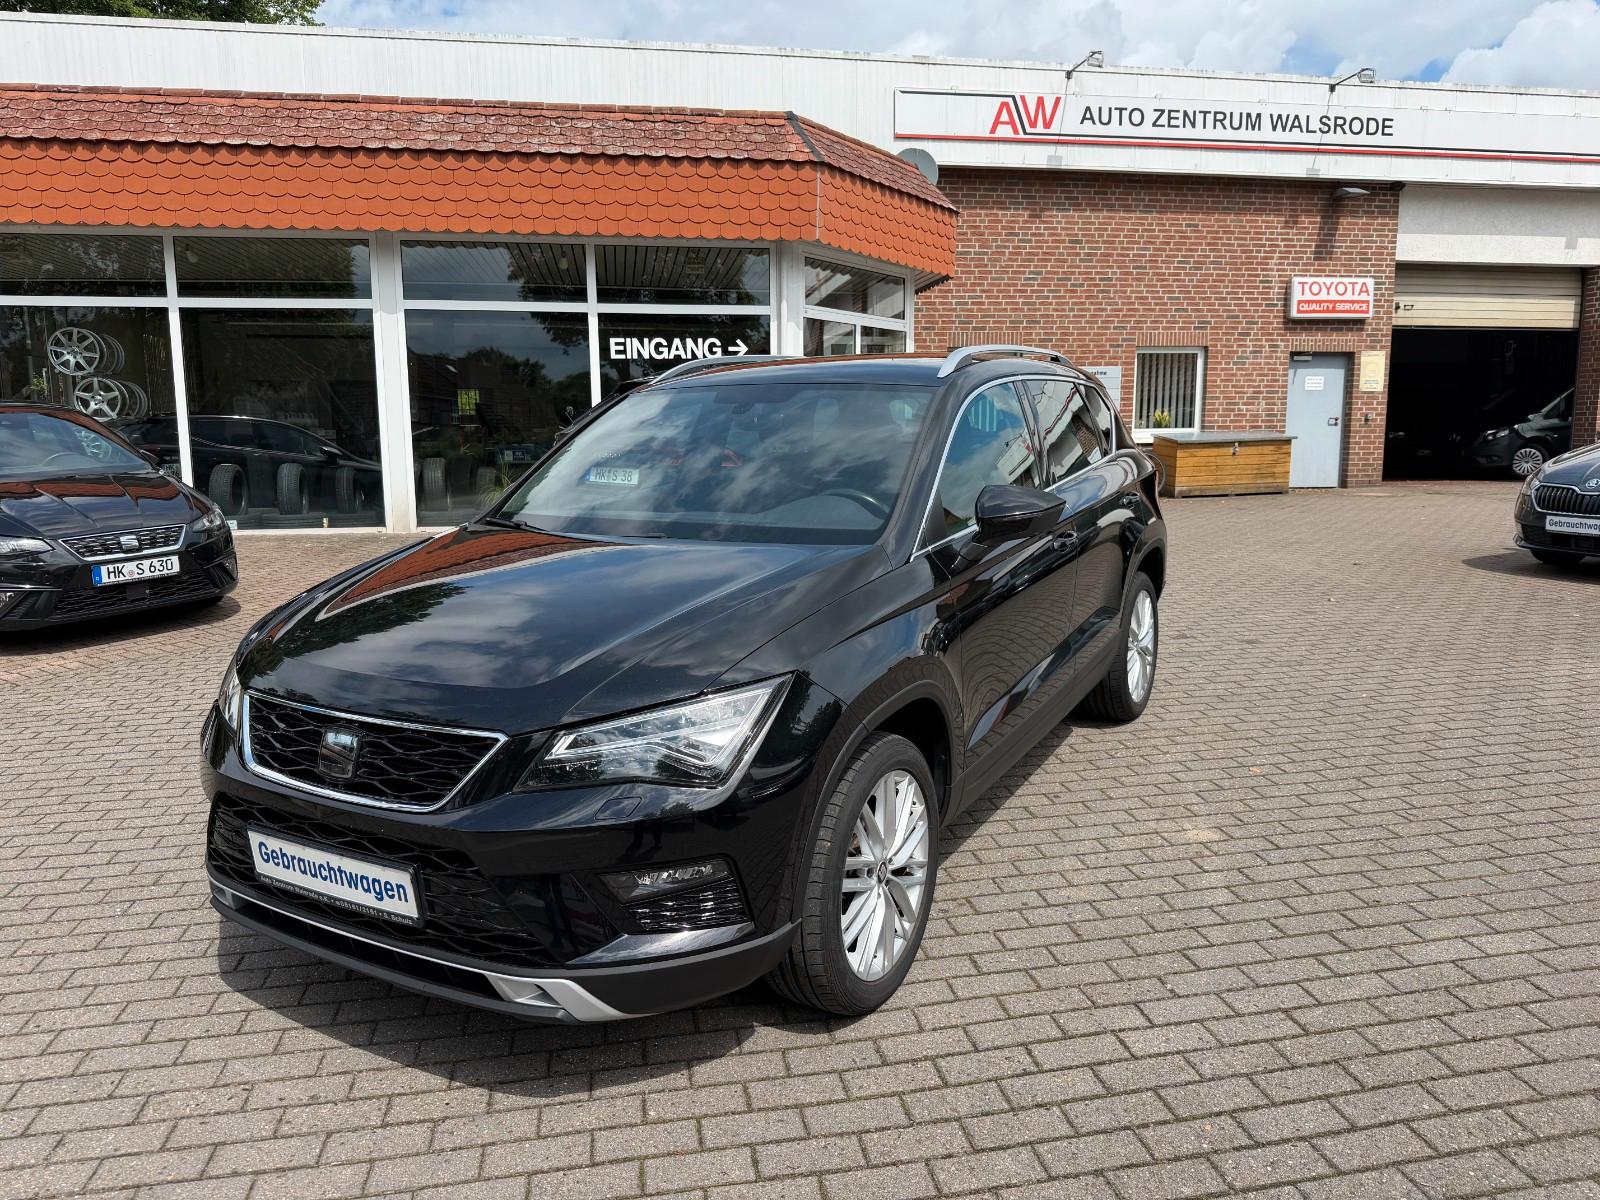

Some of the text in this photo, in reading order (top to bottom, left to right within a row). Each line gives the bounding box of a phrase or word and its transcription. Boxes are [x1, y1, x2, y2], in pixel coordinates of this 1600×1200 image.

[989, 95, 1394, 136] AW AUTO ZENTRUM WALSRODE
[1297, 281, 1370, 296] TOYOTA
[1299, 302, 1368, 311] QUALITY SERVICE
[609, 337, 722, 359] EINGANG
[594, 468, 633, 482] HK S 38
[107, 565, 126, 579] HK
[135, 563, 145, 575] S
[148, 559, 173, 573] 630
[258, 841, 409, 903] Gebrauchtwagen
